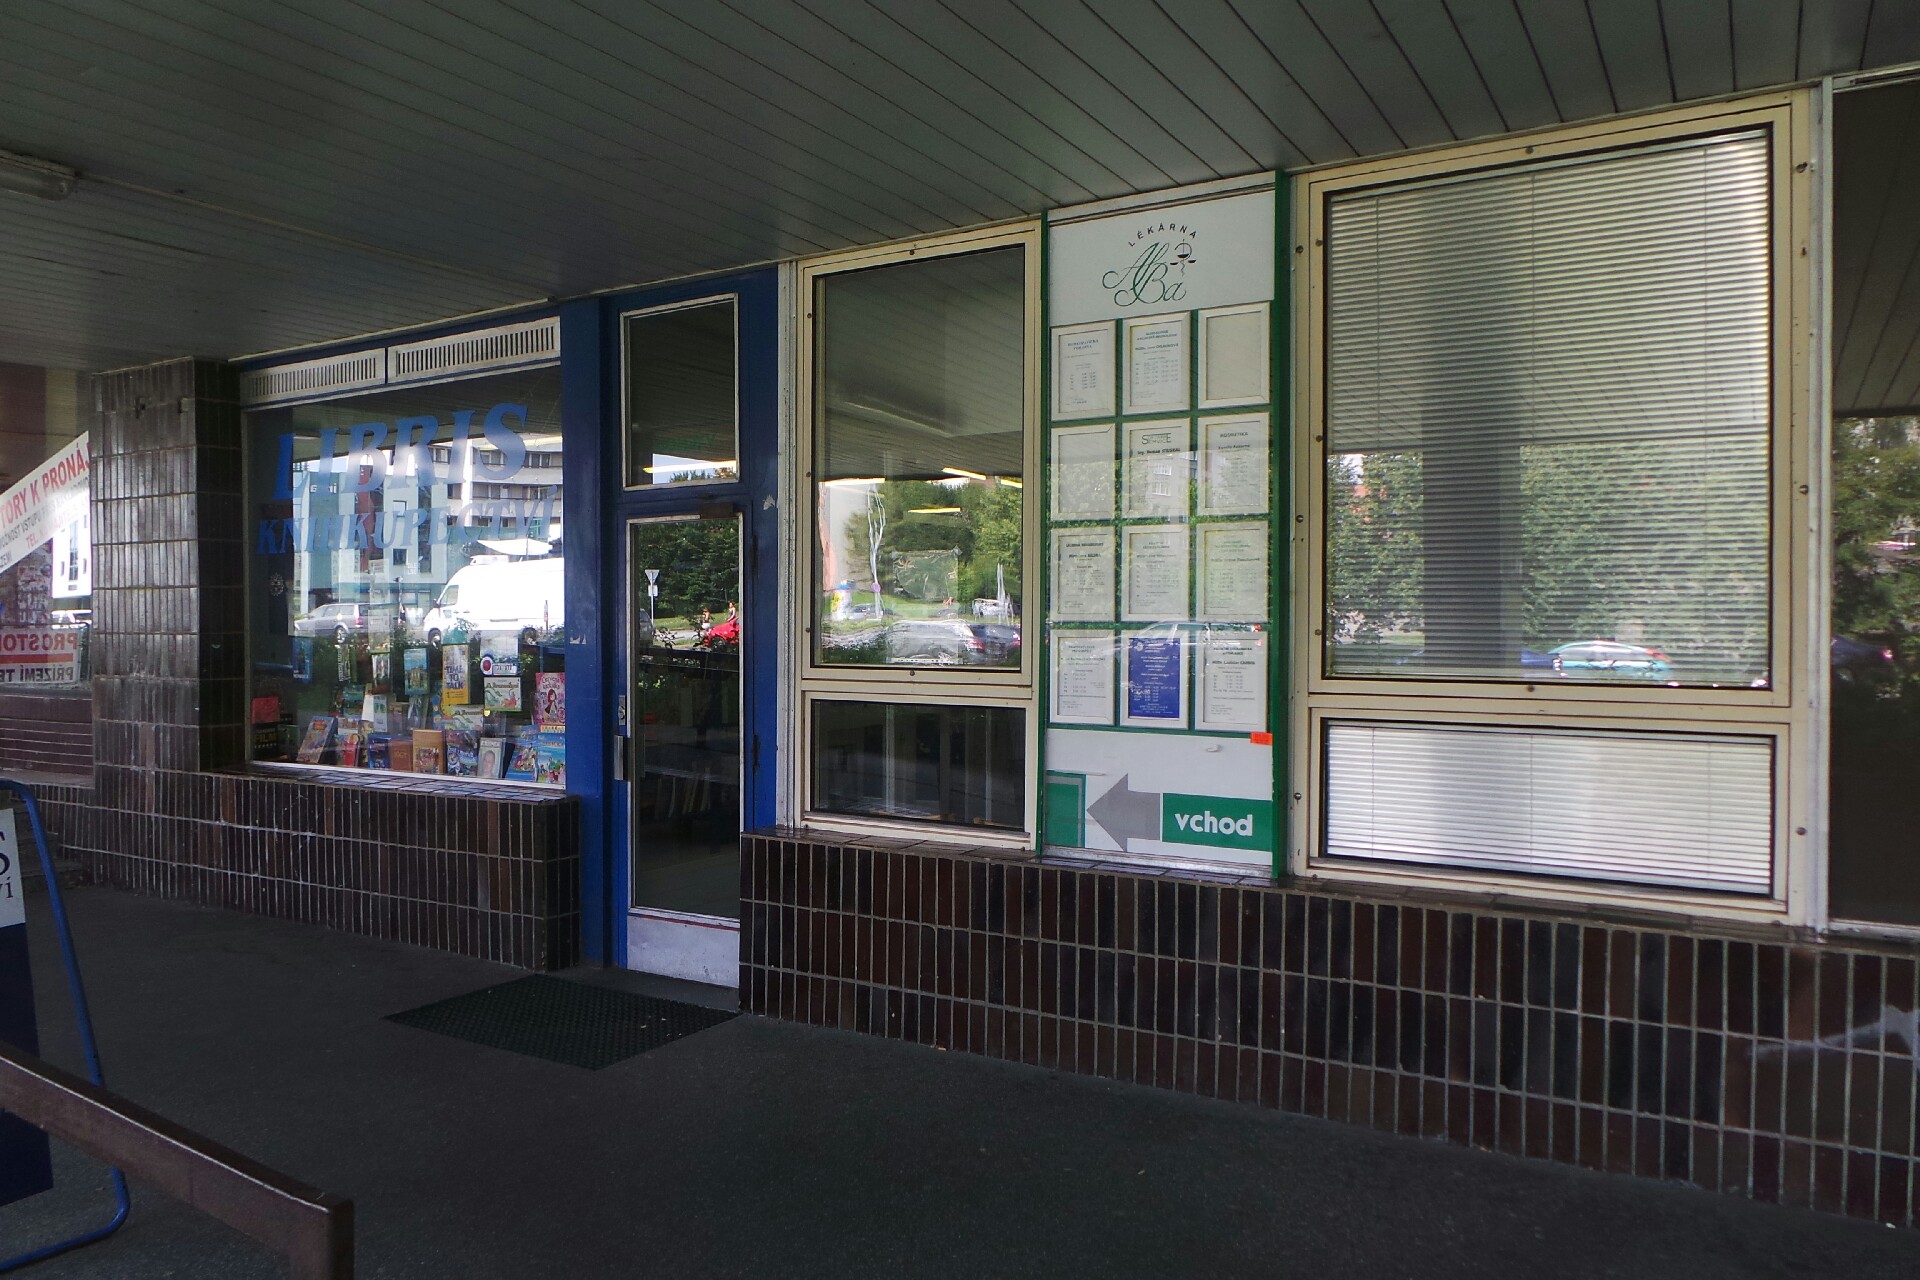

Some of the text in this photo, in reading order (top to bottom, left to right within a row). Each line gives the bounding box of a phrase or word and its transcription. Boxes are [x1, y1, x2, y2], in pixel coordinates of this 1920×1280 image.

[272, 402, 528, 500] LIBRIS
[30, 479, 41, 506] K
[1174, 810, 1254, 837] vchod
